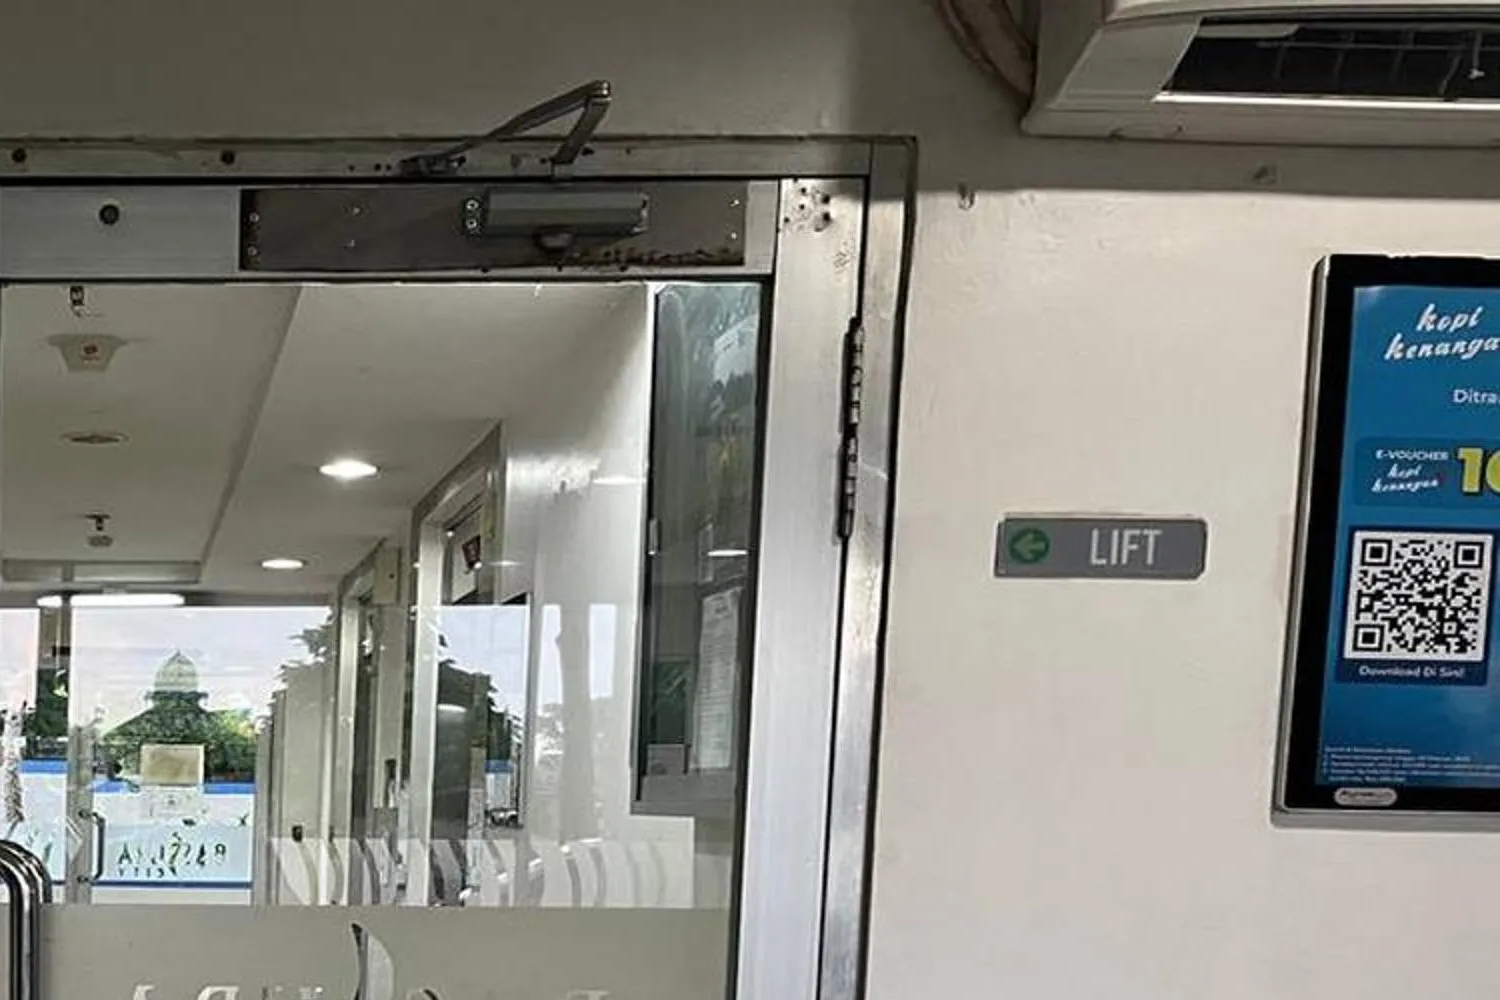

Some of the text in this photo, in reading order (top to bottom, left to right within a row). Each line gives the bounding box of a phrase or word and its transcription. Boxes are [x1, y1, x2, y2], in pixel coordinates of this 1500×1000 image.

[1416, 303, 1484, 332] kopi
[1452, 389, 1500, 404] Ditra
[1376, 449, 1448, 461] E-VOUCHER
[1089, 528, 1162, 565] LIFT
[1358, 665, 1420, 677] Download
